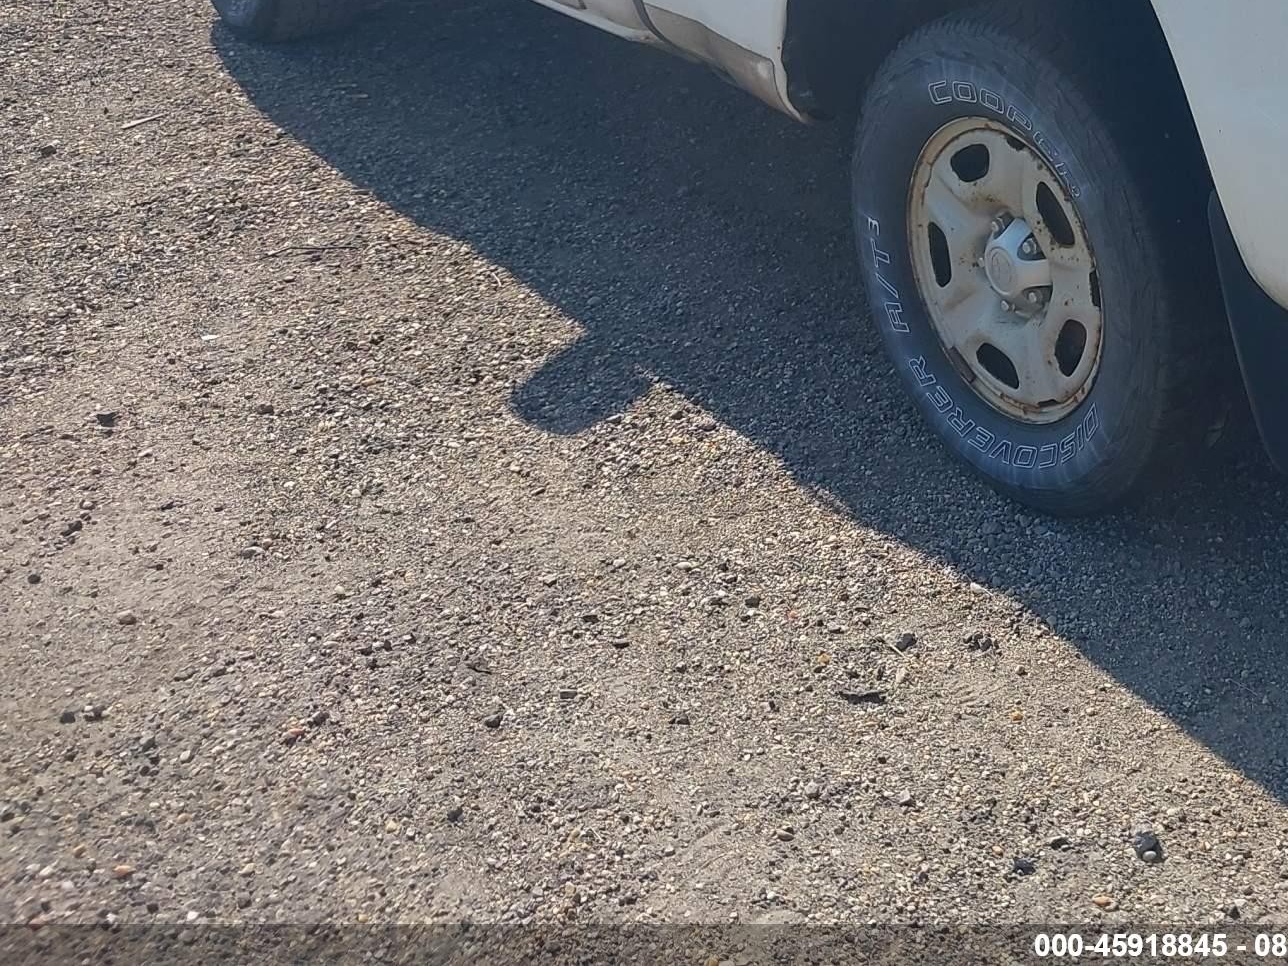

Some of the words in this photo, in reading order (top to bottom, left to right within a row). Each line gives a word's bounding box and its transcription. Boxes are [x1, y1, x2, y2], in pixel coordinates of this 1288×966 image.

[927, 80, 1081, 198] COOPER
[867, 217, 910, 332] A/T3
[908, 355, 1101, 469] DISCOVERER
